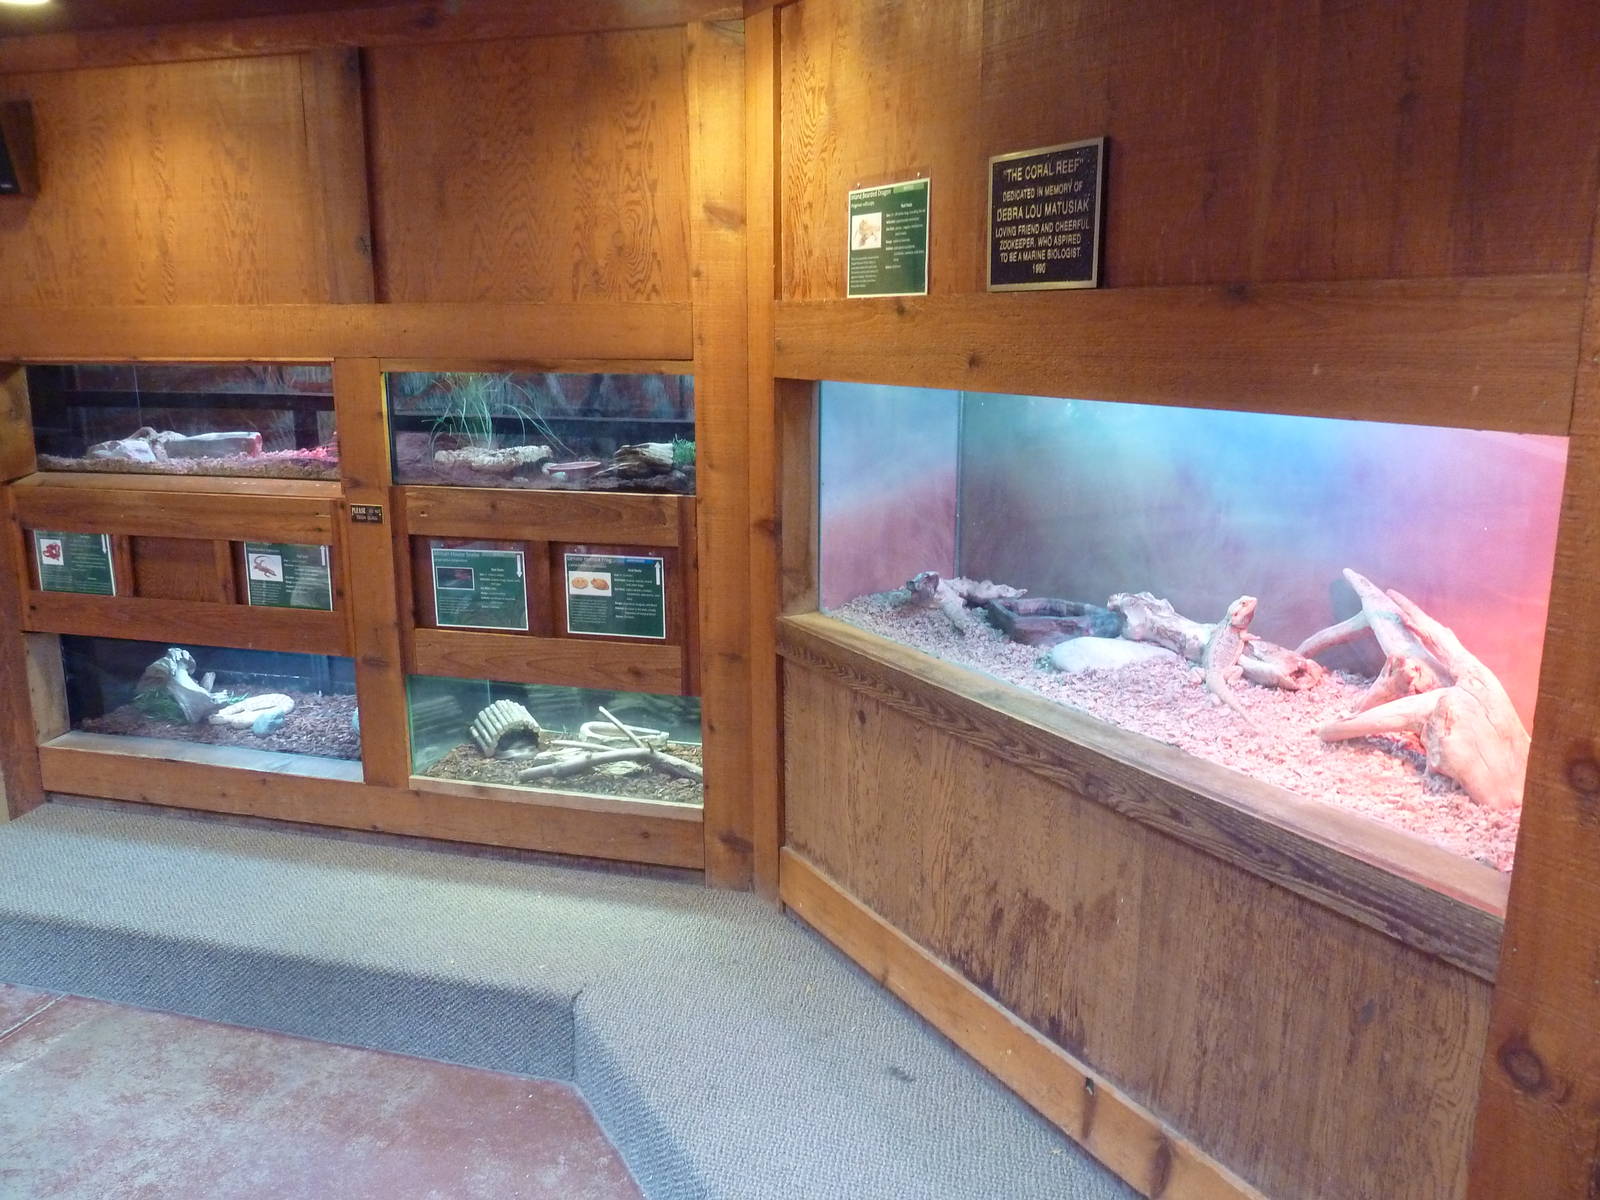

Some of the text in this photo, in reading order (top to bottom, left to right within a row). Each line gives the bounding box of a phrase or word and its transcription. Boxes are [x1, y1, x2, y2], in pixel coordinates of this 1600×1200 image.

[1025, 163, 1055, 179] CORAL
[1002, 180, 1083, 202] DEDICATED IN MEMORY OF
[996, 199, 1089, 222] DEBRA LOU MATUSIAK
[995, 218, 1089, 238] LOVING FRIEND AND CHEERFUL
[1037, 236, 1052, 246] WHO
[1053, 234, 1081, 246] ASPIRED
[1000, 252, 1008, 263] TO
[1009, 251, 1017, 262] BE
[1017, 251, 1022, 261] A
[1023, 249, 1046, 261] MARINE
